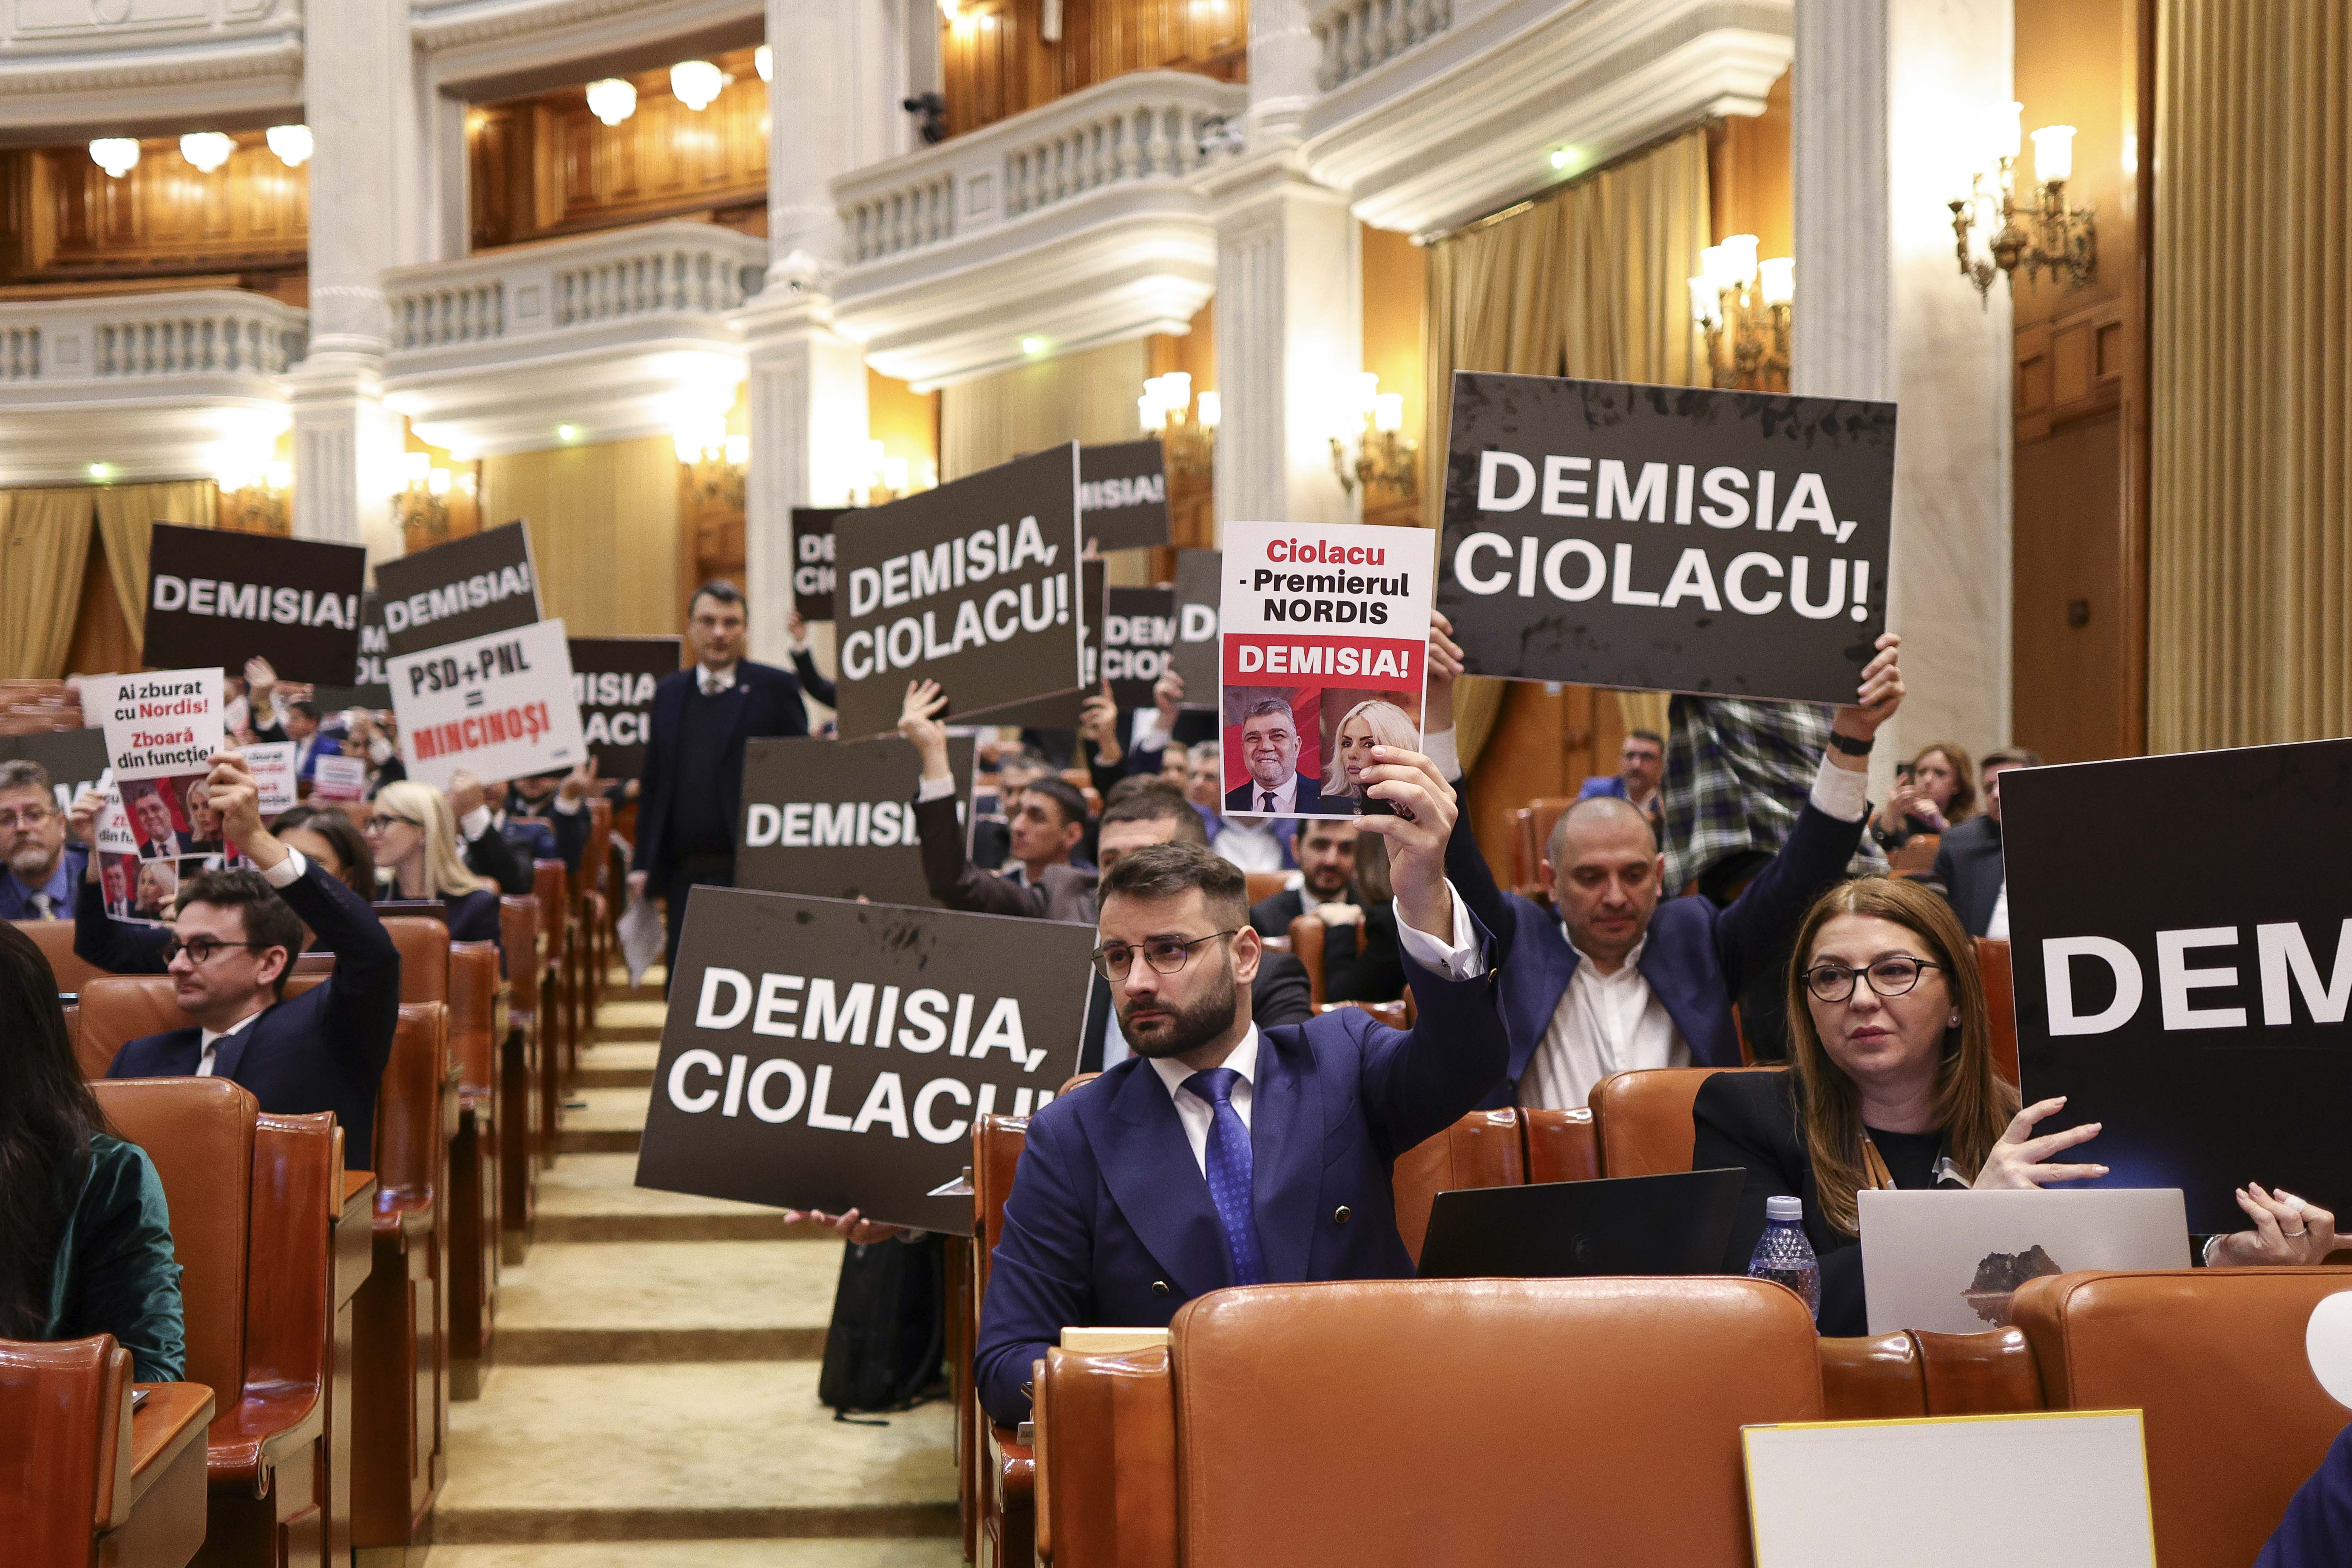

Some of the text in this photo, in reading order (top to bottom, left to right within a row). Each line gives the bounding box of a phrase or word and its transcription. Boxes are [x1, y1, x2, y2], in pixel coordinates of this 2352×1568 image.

[1477, 449, 1858, 544] DEMISIA,
[849, 515, 1058, 617] DEMISIA,
[1267, 538, 1385, 566] Ciolacu
[384, 561, 532, 634] DEMISIA!
[1254, 568, 1410, 597] Premierul
[1454, 532, 1870, 623] CIOLACU!
[154, 574, 357, 630] DEMISIA!
[1263, 598, 1388, 625] NORDIS
[842, 572, 1069, 681] CIOLACU!
[1238, 645, 1410, 679] DEMISIA!
[115, 698, 208, 721] cu Nordis!
[118, 680, 202, 701] Ai zburat
[117, 752, 145, 769] din
[694, 966, 1048, 1073] DEMISIA,
